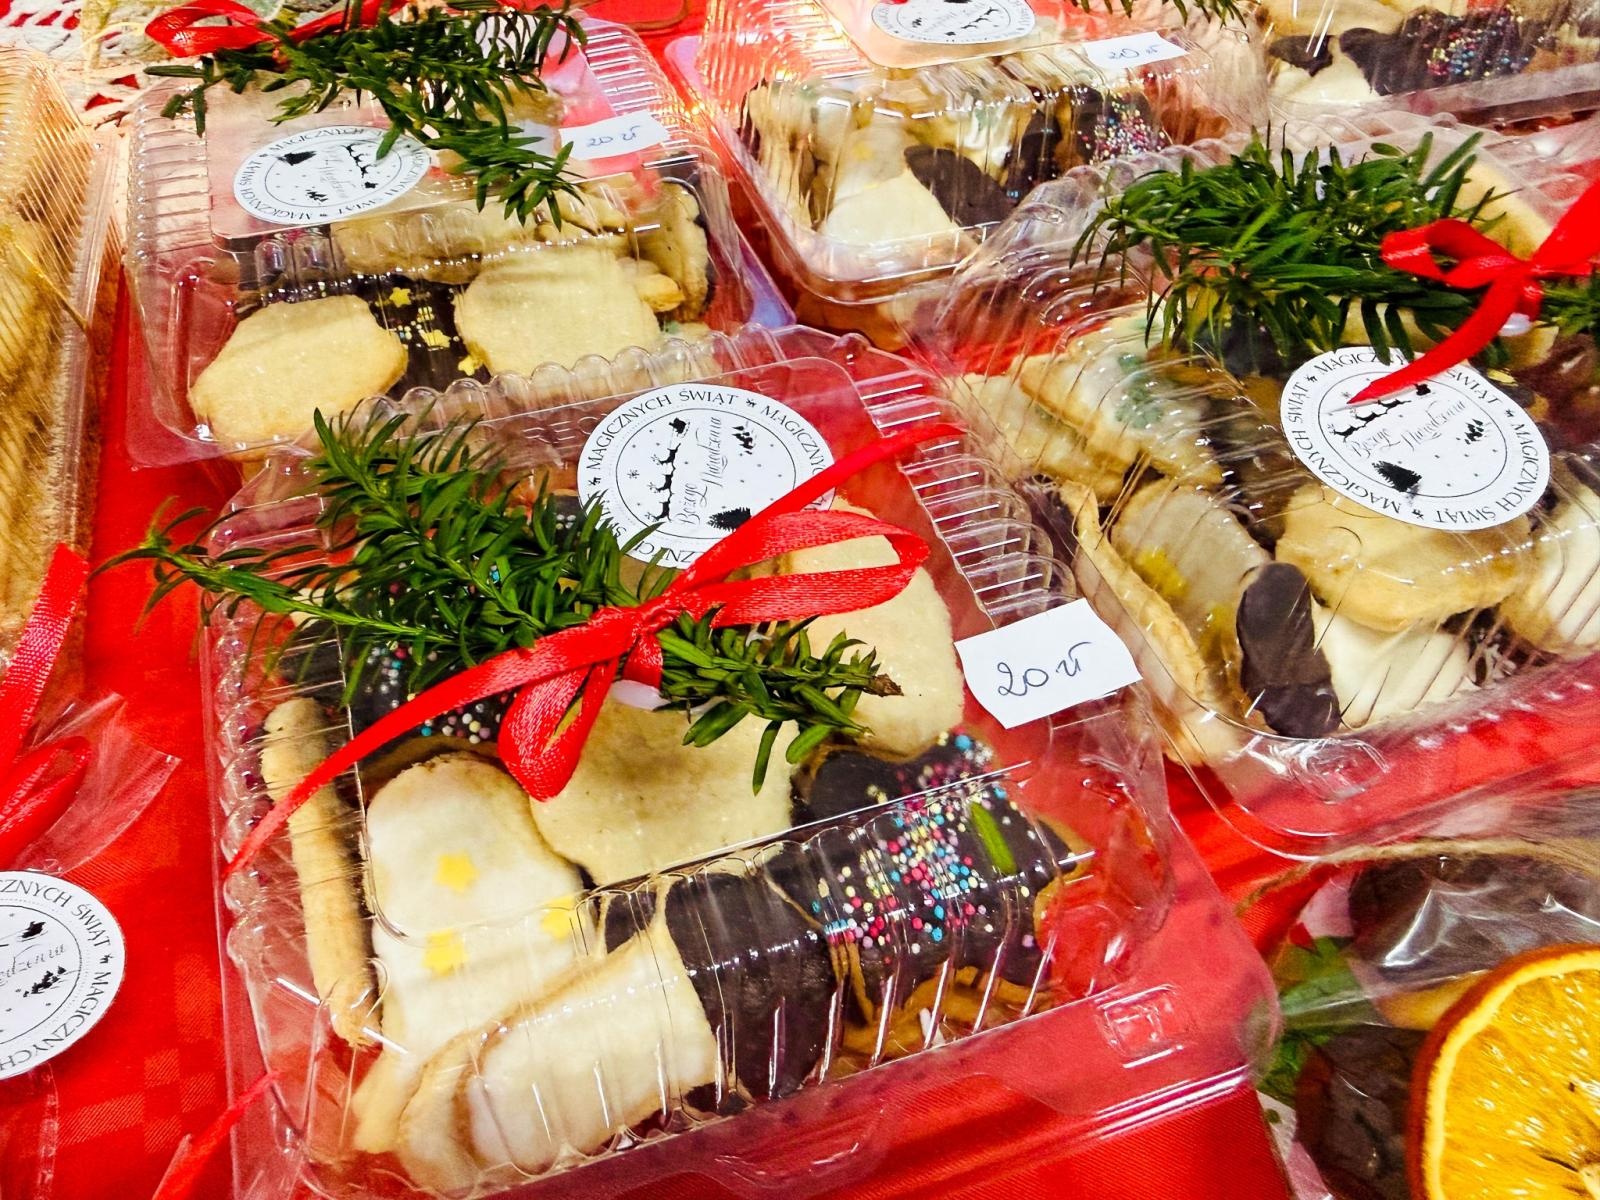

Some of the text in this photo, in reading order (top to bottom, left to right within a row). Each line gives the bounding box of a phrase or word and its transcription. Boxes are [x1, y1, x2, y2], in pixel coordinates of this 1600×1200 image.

[586, 388, 740, 470] MAGICZNYCH ŚWIĄT
[760, 405, 825, 474] MAGICZNY
[1291, 430, 1400, 514] MAGICZNYCH
[1495, 423, 1540, 512] MAGICZNYCH
[997, 662, 1049, 697] 20
[71, 903, 111, 947] ŚWIĄT
